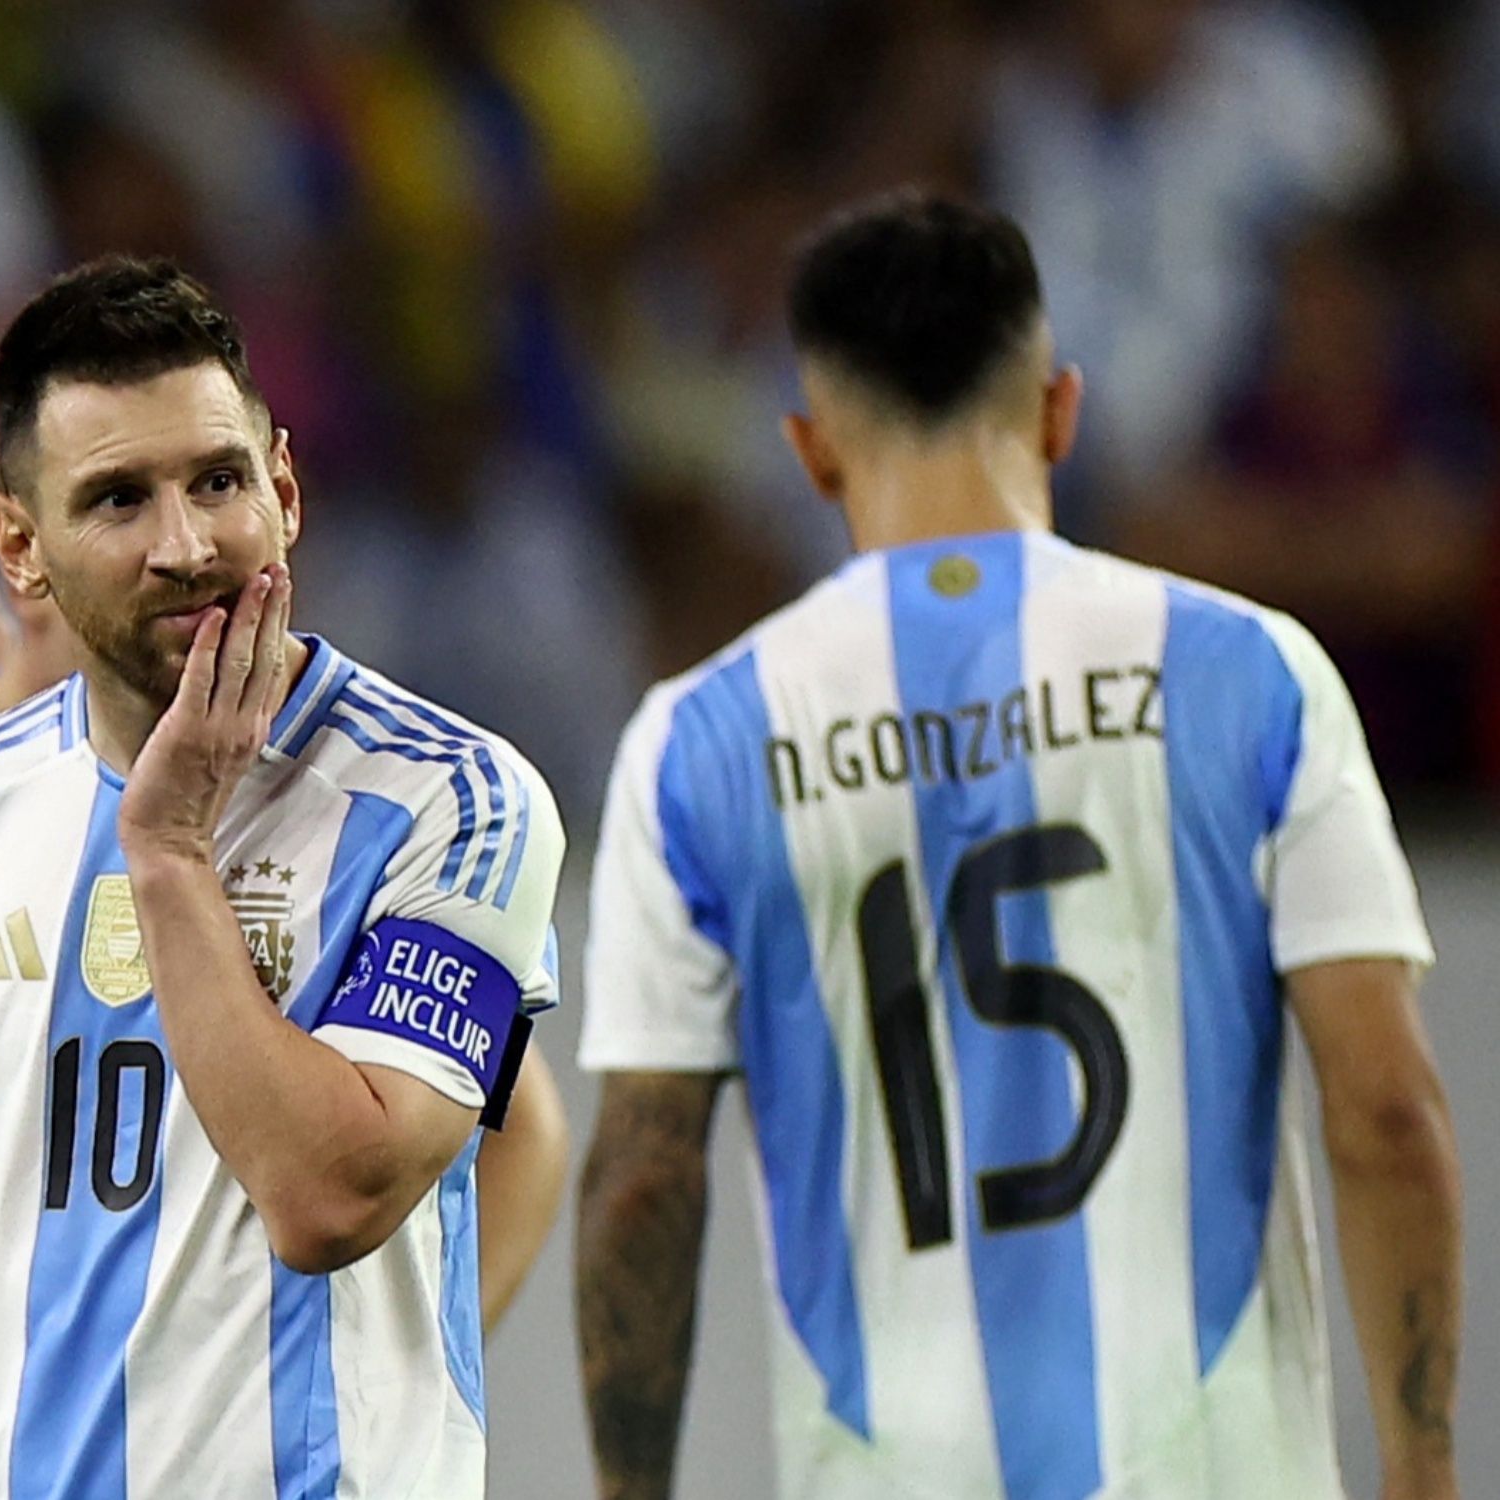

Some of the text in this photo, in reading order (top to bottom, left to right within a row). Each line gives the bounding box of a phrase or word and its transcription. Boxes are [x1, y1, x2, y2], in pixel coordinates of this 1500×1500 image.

[369, 982, 491, 1071] INCLUIR
[385, 939, 477, 1005] ELIGE
[857, 823, 1129, 1251] 15
[45, 1037, 165, 1212] 10
